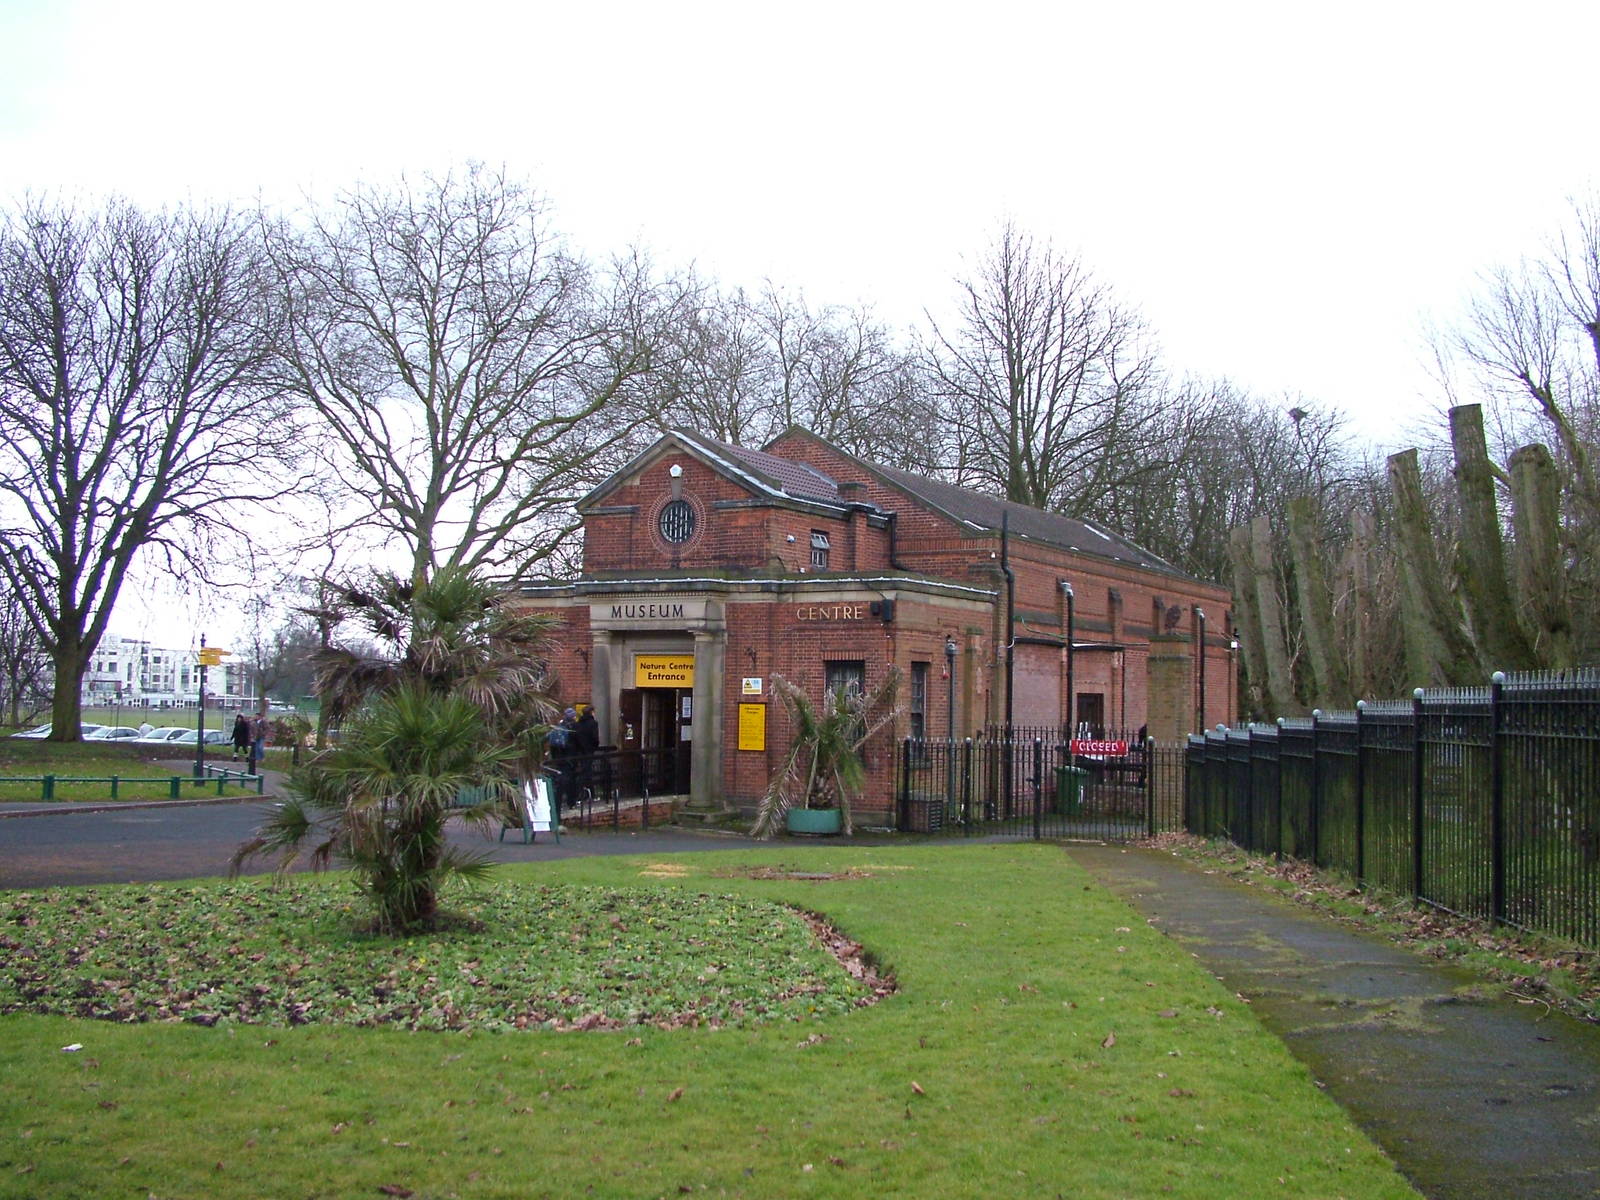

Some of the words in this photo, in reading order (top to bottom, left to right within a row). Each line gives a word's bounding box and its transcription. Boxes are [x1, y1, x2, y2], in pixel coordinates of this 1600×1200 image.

[611, 604, 683, 619] MUSEUM
[796, 606, 864, 620] CENTRE
[640, 662, 666, 670] Nature
[669, 662, 694, 670] Centre
[647, 672, 686, 681] Entrance
[1079, 742, 1119, 752] CLOSED
